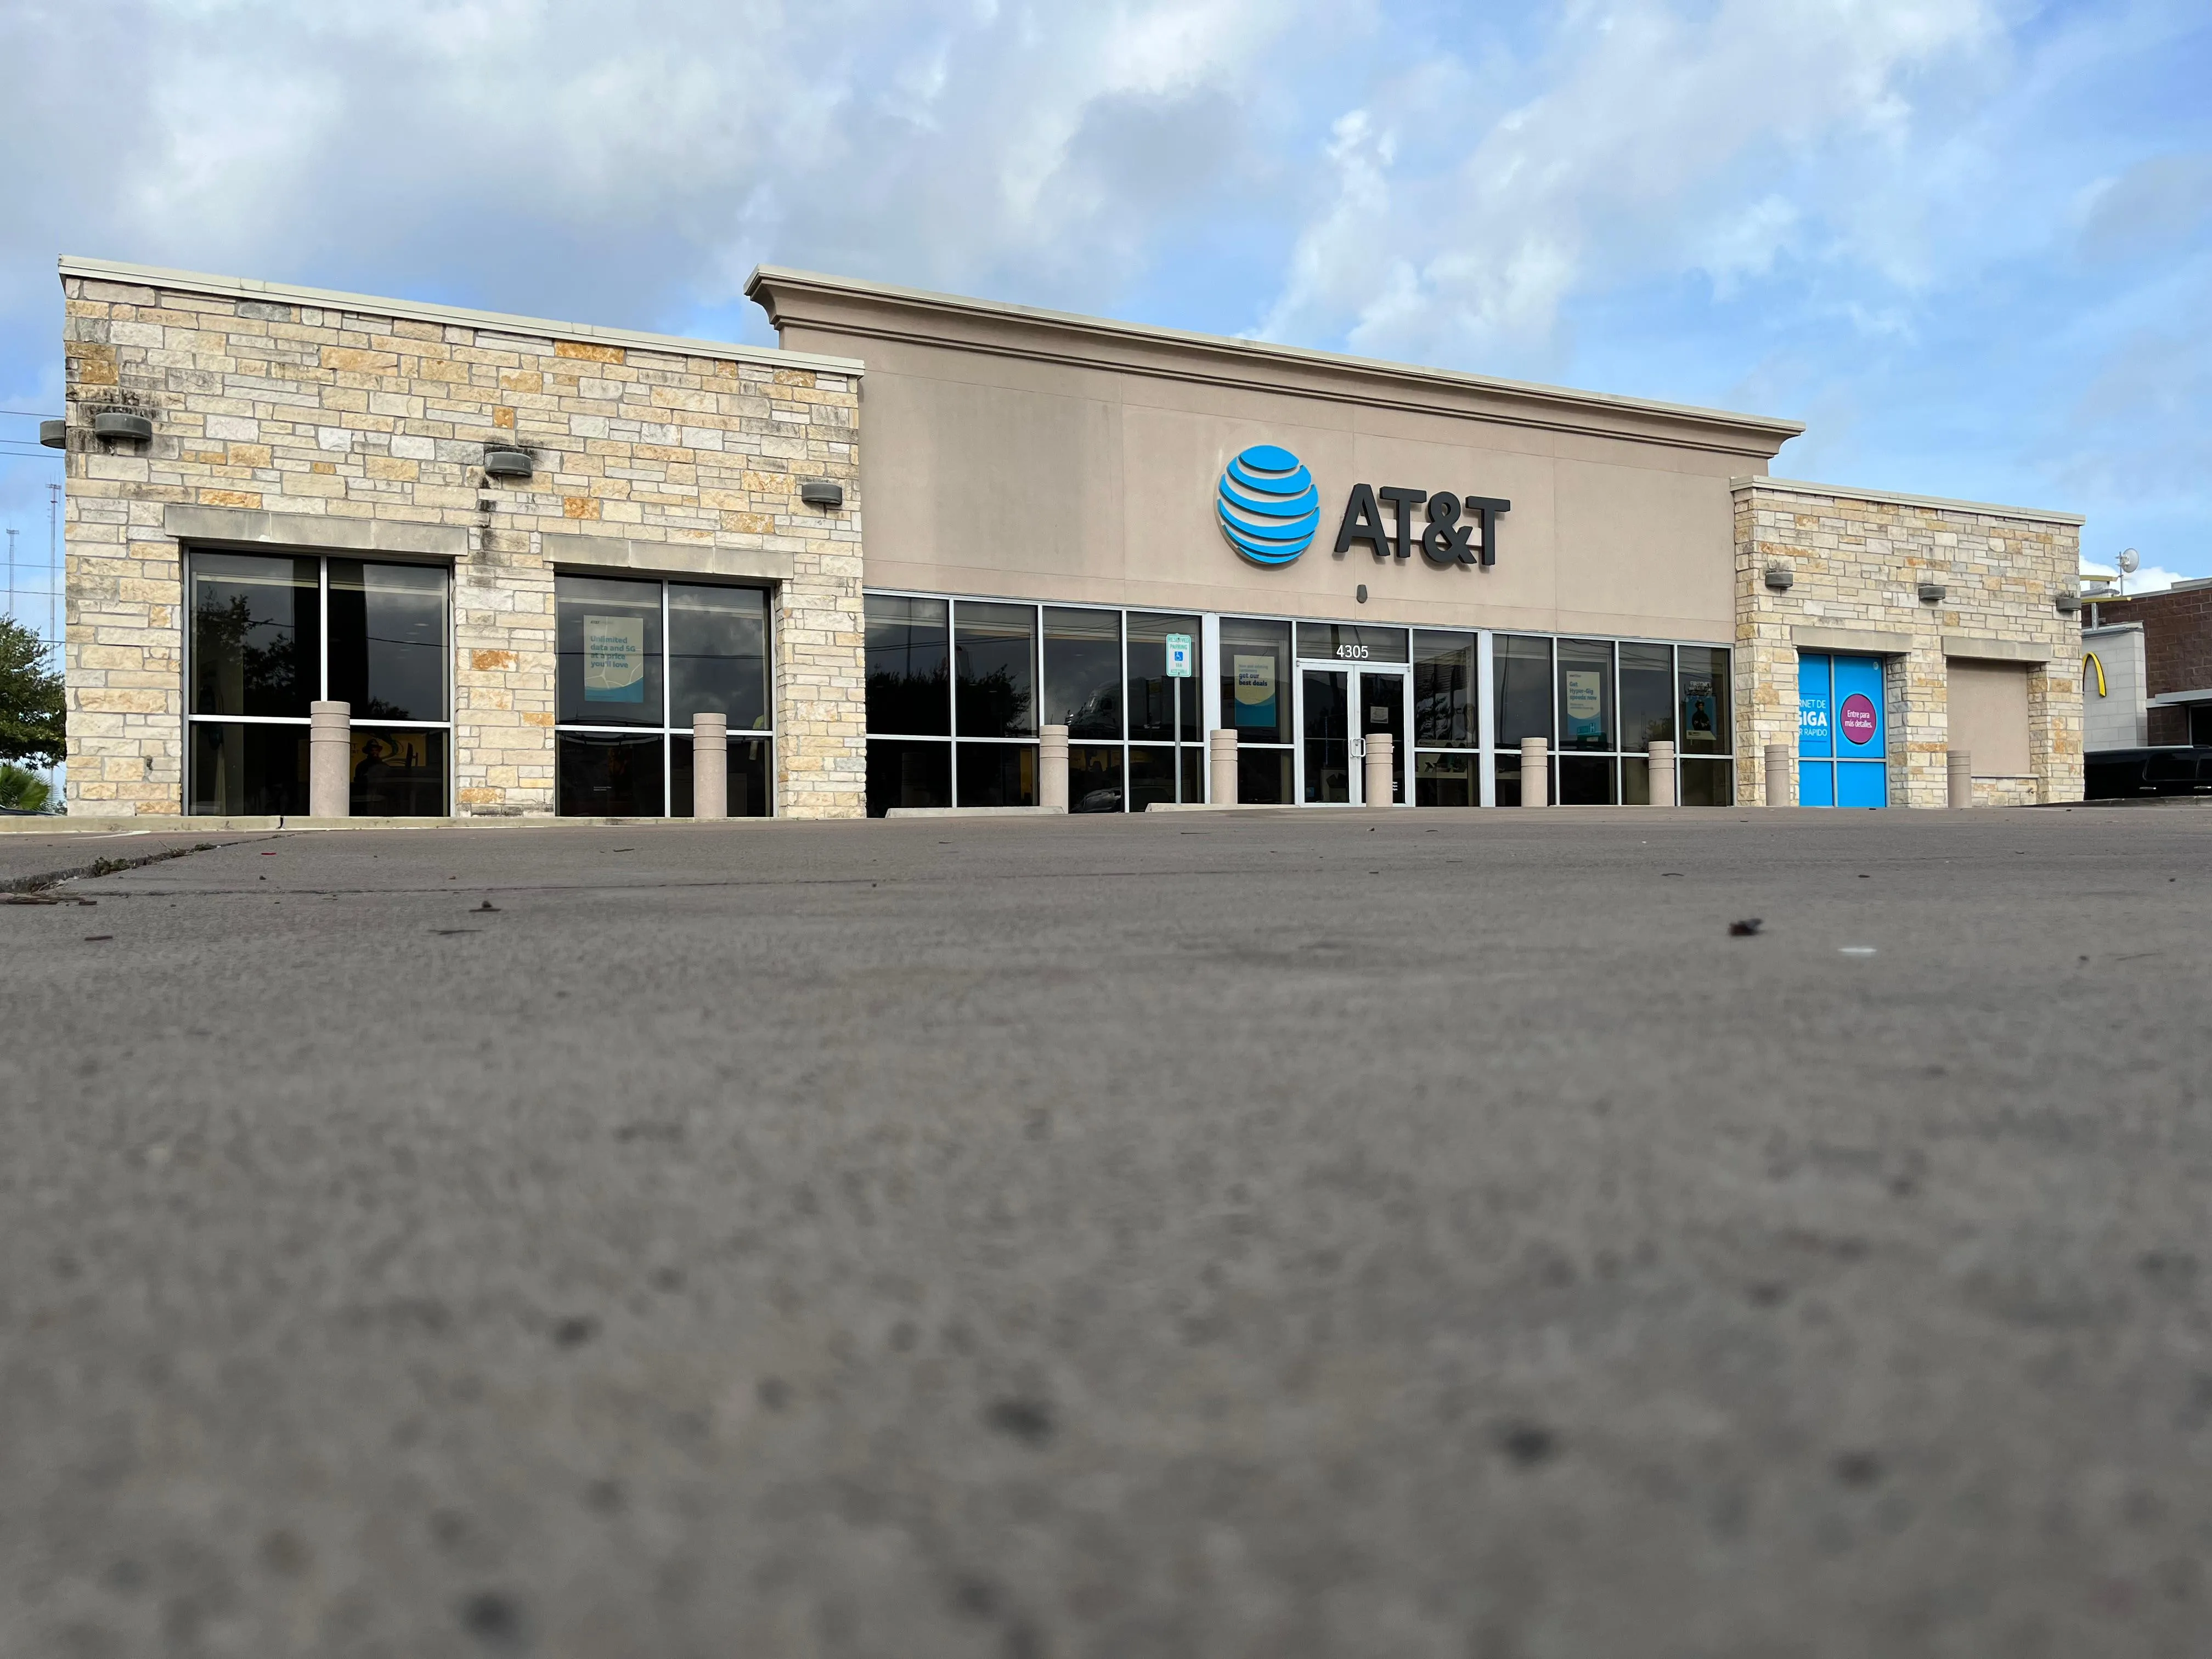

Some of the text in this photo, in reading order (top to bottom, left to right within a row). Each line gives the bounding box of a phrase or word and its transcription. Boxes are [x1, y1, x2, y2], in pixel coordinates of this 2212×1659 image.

[1334, 483, 1511, 566] AT&T
[1336, 645, 1368, 658] 4305
[1816, 699, 1826, 709] DE
[1847, 710, 1860, 718] Entre
